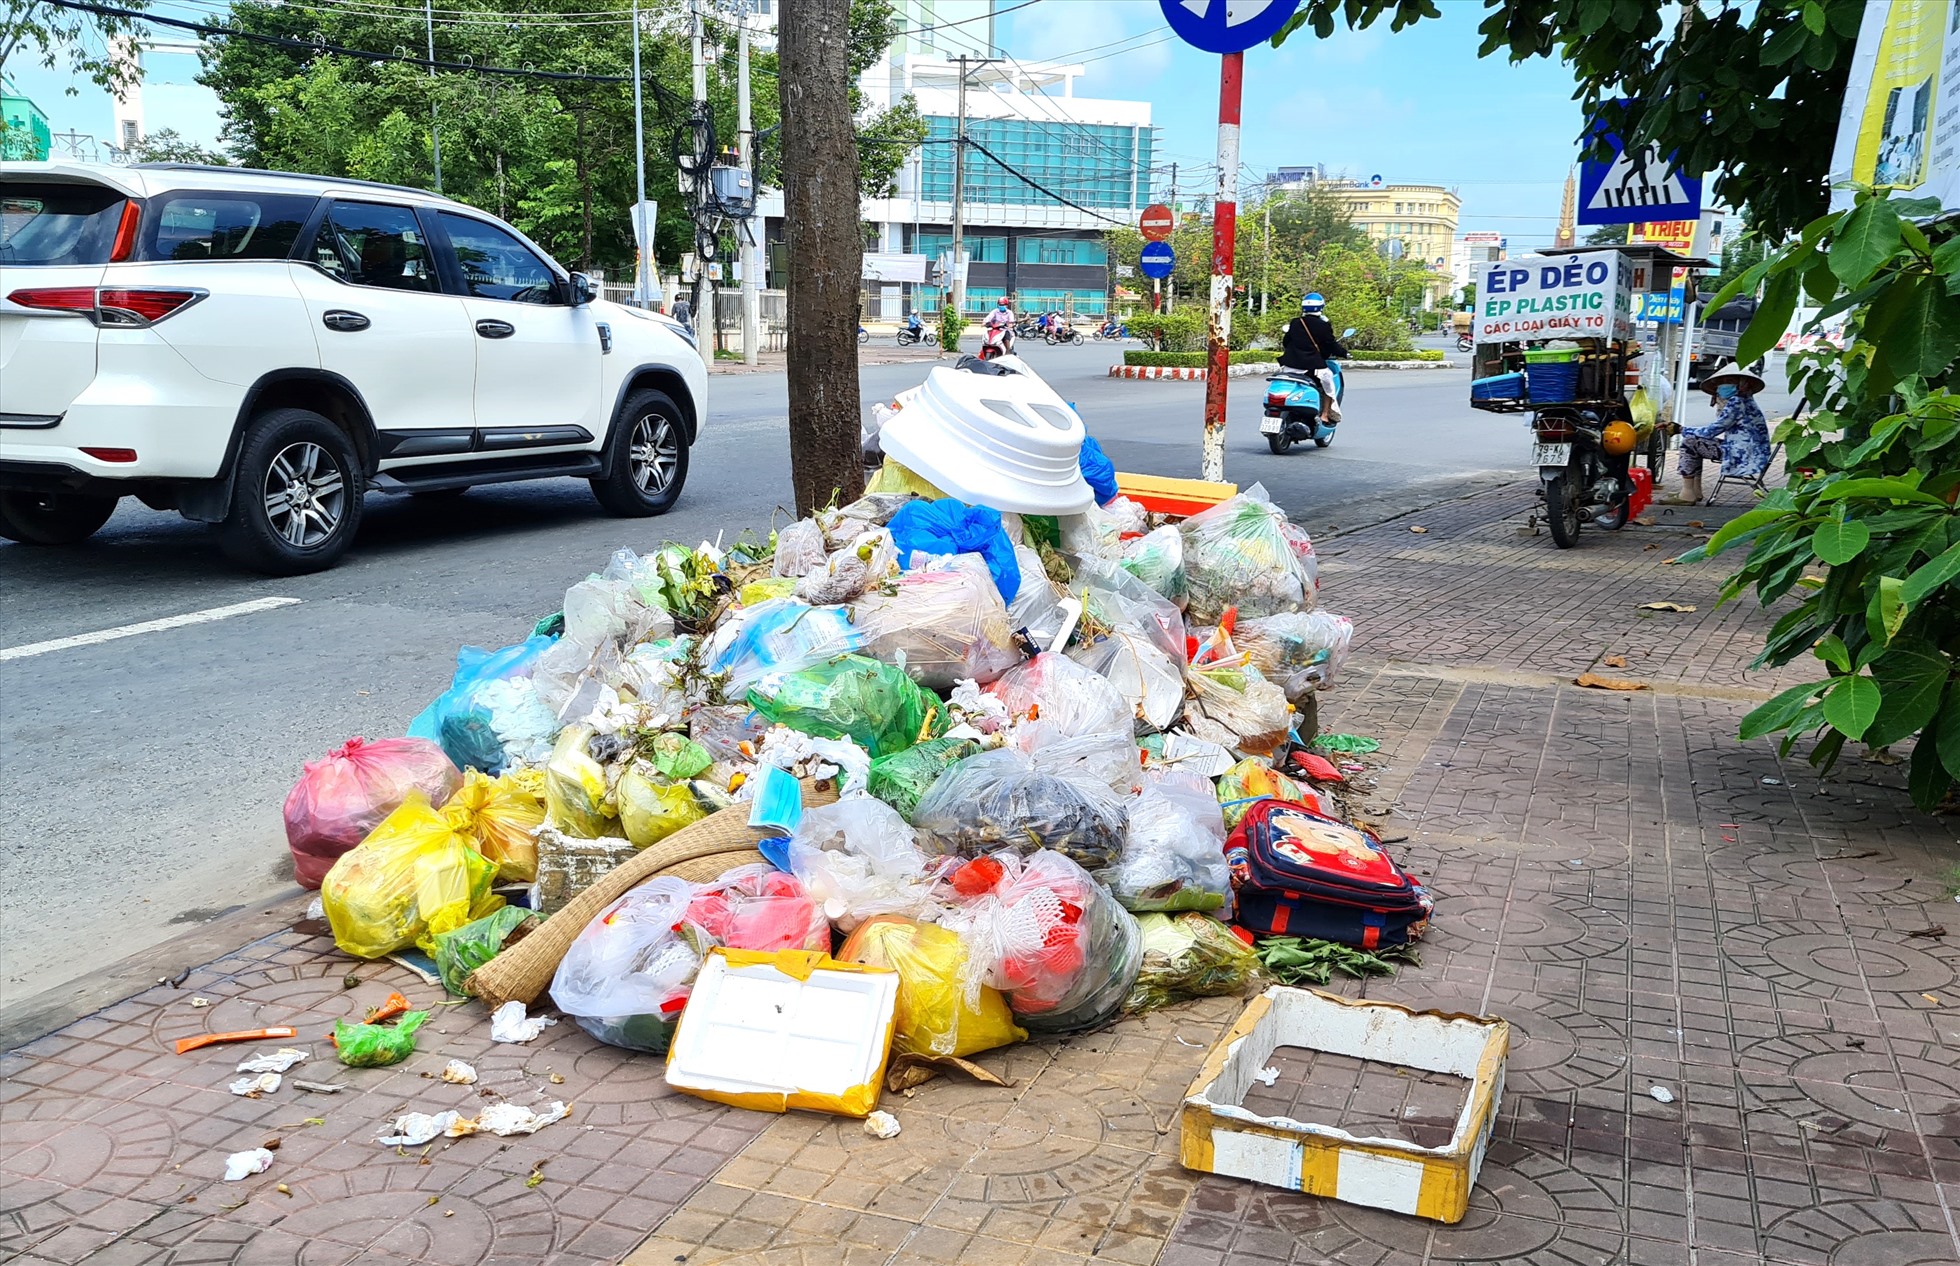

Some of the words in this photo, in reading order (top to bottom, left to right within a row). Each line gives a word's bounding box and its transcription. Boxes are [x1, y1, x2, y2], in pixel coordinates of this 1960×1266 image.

[1486, 264, 1530, 294] ÉP
[1540, 255, 1609, 290] DẺO
[1485, 297, 1511, 318] ÉP
[1516, 292, 1603, 315] PLASTIC
[1484, 321, 1511, 335] CÁC
[1515, 319, 1544, 335] LOẠI
[1548, 314, 1581, 329] GIẤY
[1585, 314, 1604, 328] TỜ
